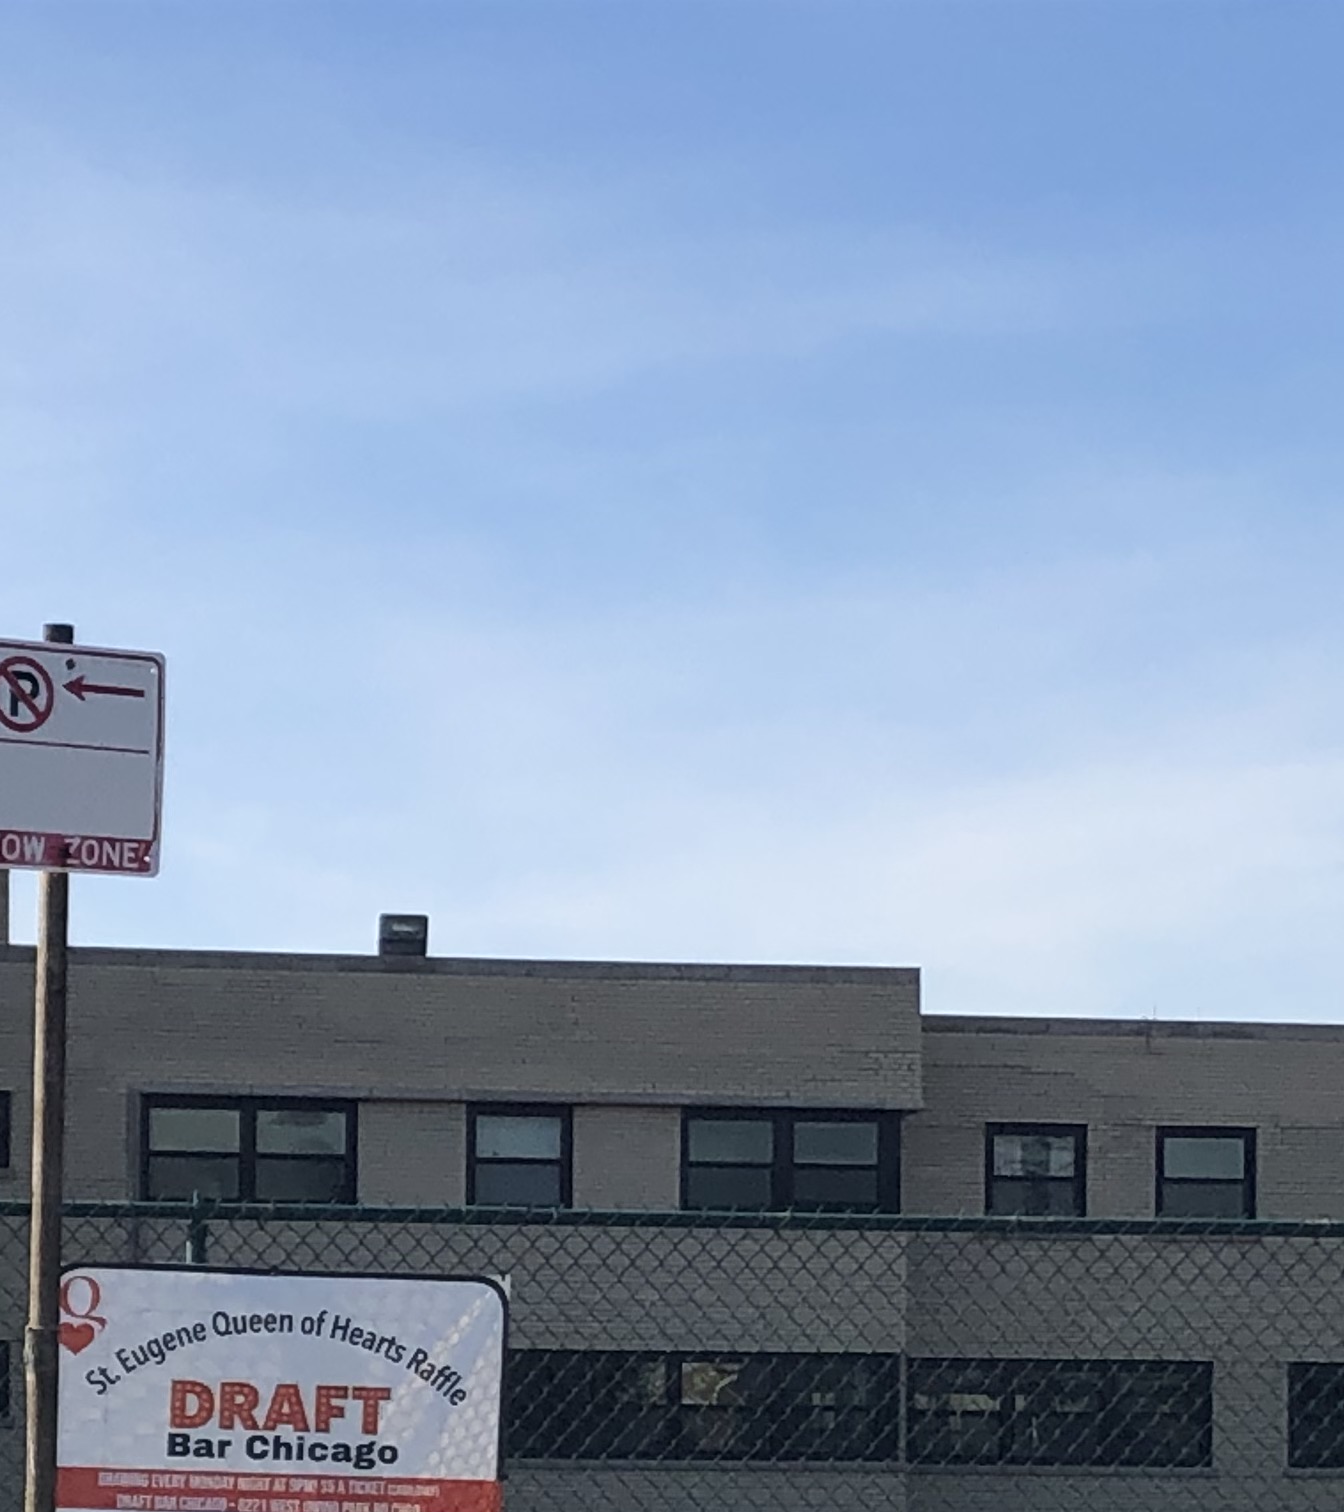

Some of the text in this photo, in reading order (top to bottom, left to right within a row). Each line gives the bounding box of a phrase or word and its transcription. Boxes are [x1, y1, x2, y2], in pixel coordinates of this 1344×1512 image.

[64, 838, 141, 868] ZONE
[58, 1275, 107, 1332] Q
[85, 1310, 468, 1406] St. Eugene Queen of Hearts Raffle
[169, 1379, 392, 1436] DRAFT
[166, 1432, 399, 1470] Bar Chicago
